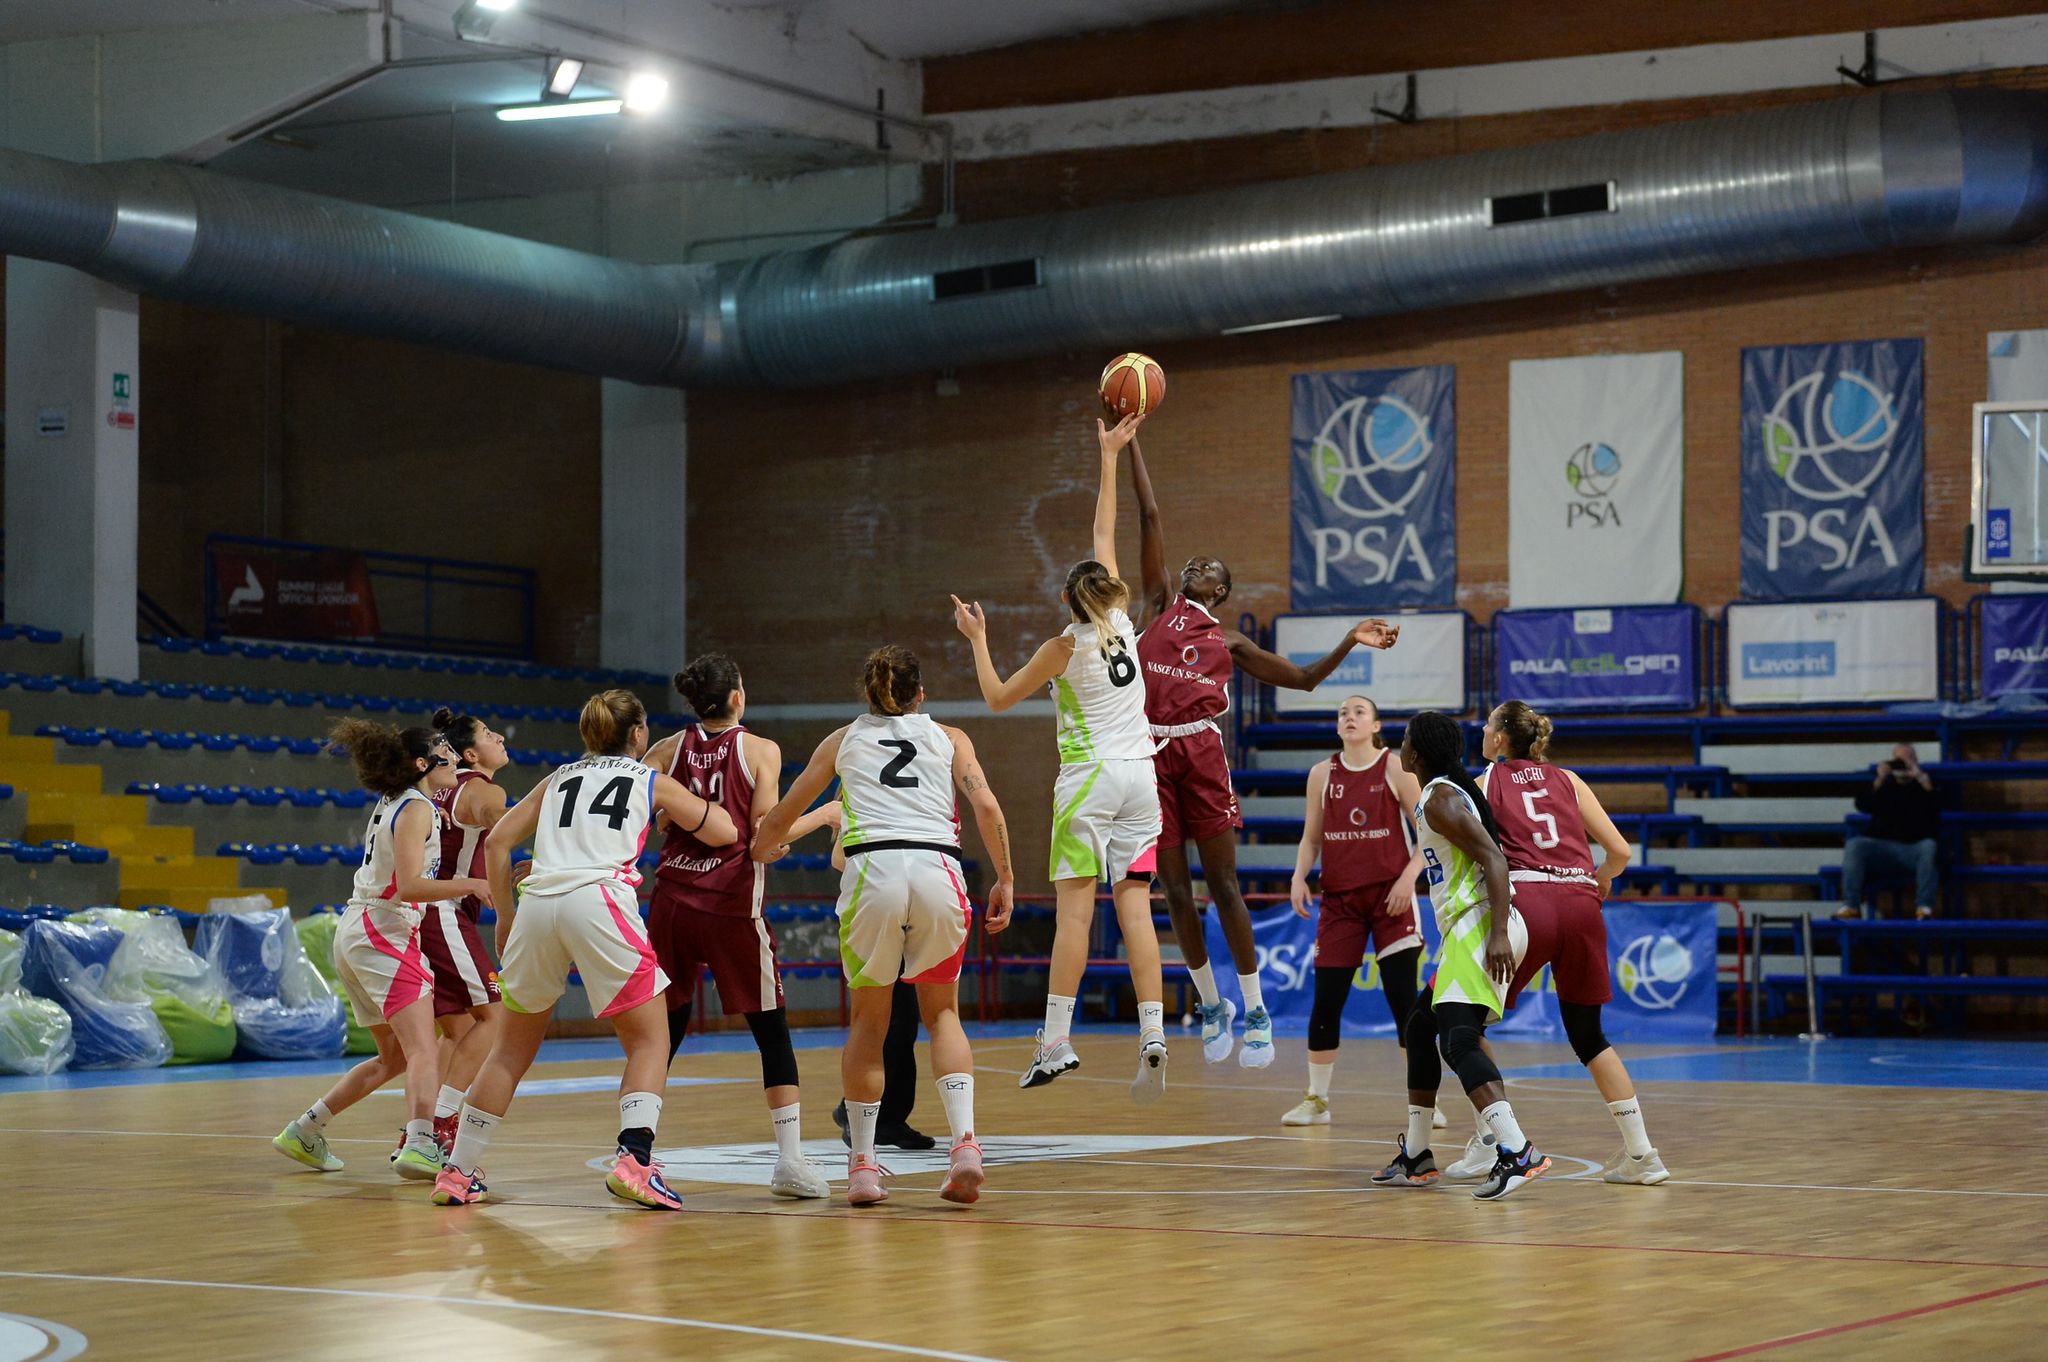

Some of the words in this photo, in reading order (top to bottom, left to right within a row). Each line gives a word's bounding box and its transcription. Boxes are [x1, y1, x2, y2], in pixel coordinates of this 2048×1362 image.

[1567, 502, 1621, 529] PSA
[1762, 506, 1899, 572] PSA
[1314, 523, 1436, 588] PSA
[1168, 615, 1188, 631] 15
[1146, 661, 1172, 675] NASCE
[1171, 667, 1184, 678] UN
[1510, 658, 1568, 676] PALA
[1749, 654, 1828, 674] Lavorint
[878, 740, 919, 788] 2
[1511, 766, 1546, 785] ORCHI
[1329, 783, 1344, 799] 13
[557, 775, 634, 831] 14
[1521, 787, 1560, 849] 5
[1324, 831, 1347, 840] NASCE
[1347, 831, 1359, 840] UN
